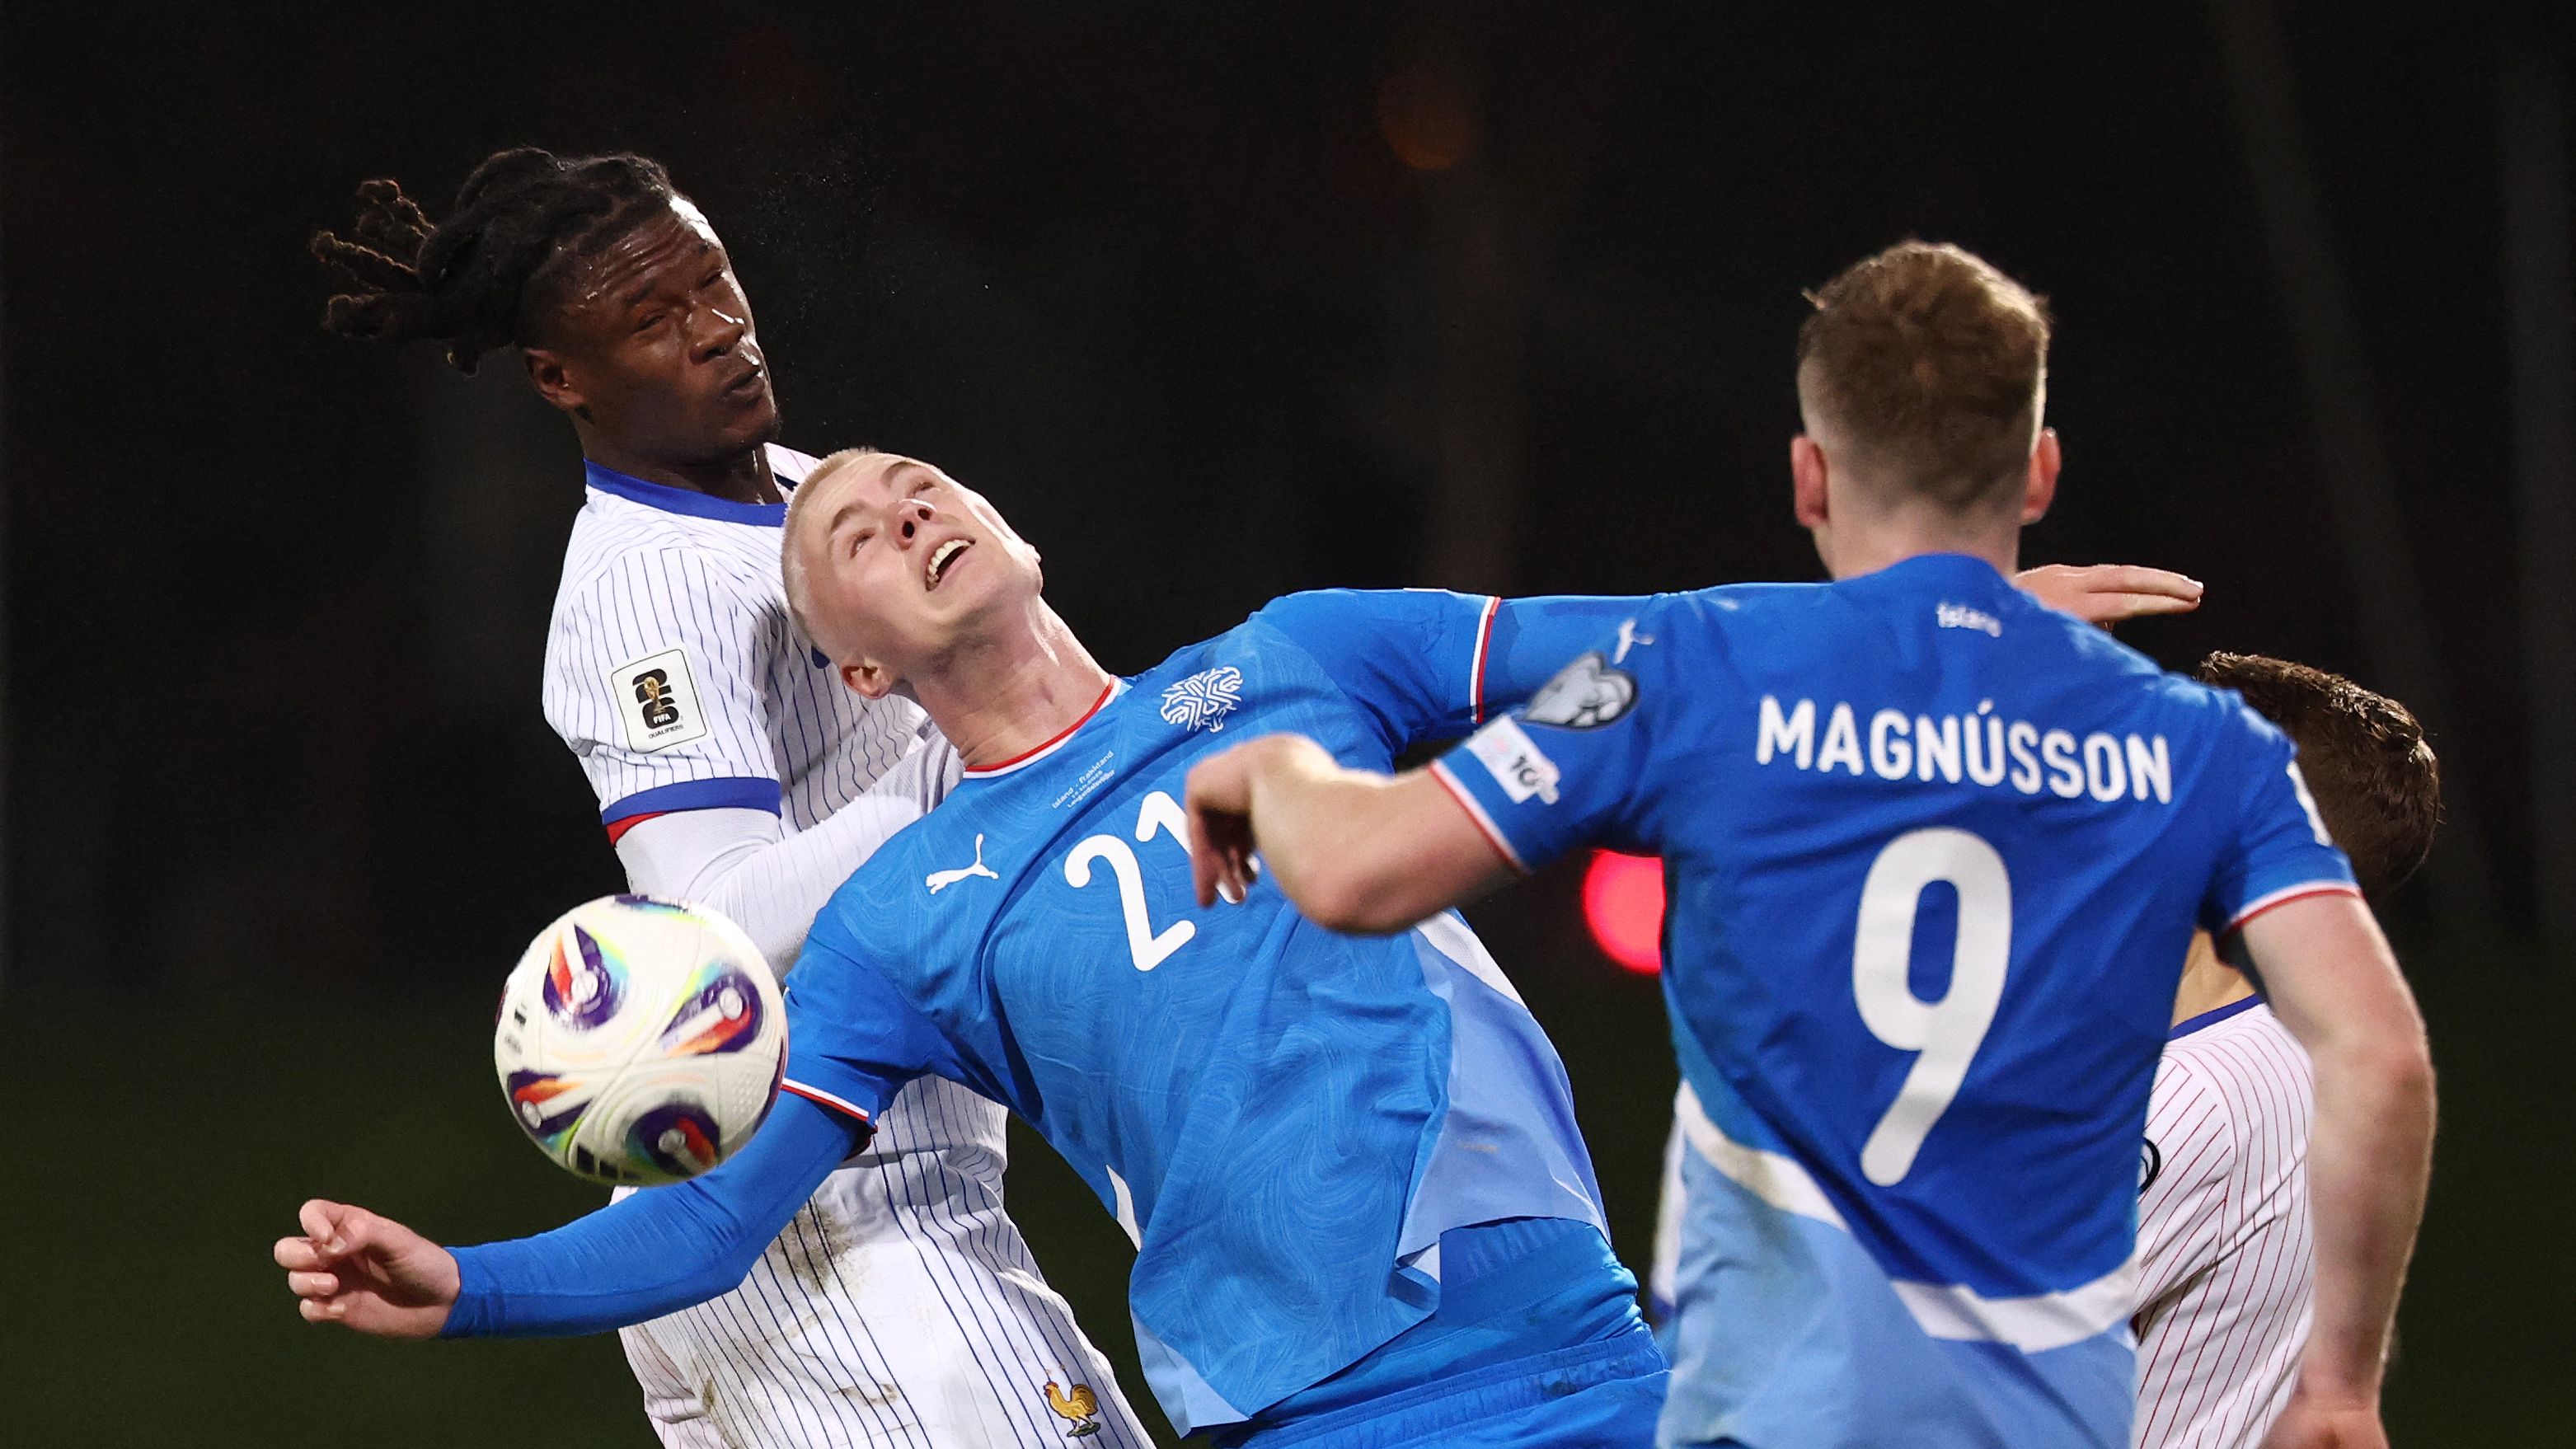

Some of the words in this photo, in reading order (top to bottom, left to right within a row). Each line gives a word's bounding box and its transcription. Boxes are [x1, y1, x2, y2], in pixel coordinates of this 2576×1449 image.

[648, 724, 684, 739] QUALIFIERS
[653, 713, 672, 724] FIFA
[1757, 694, 2171, 804] MAGNÚSSON
[1852, 825, 2013, 1187] 9
